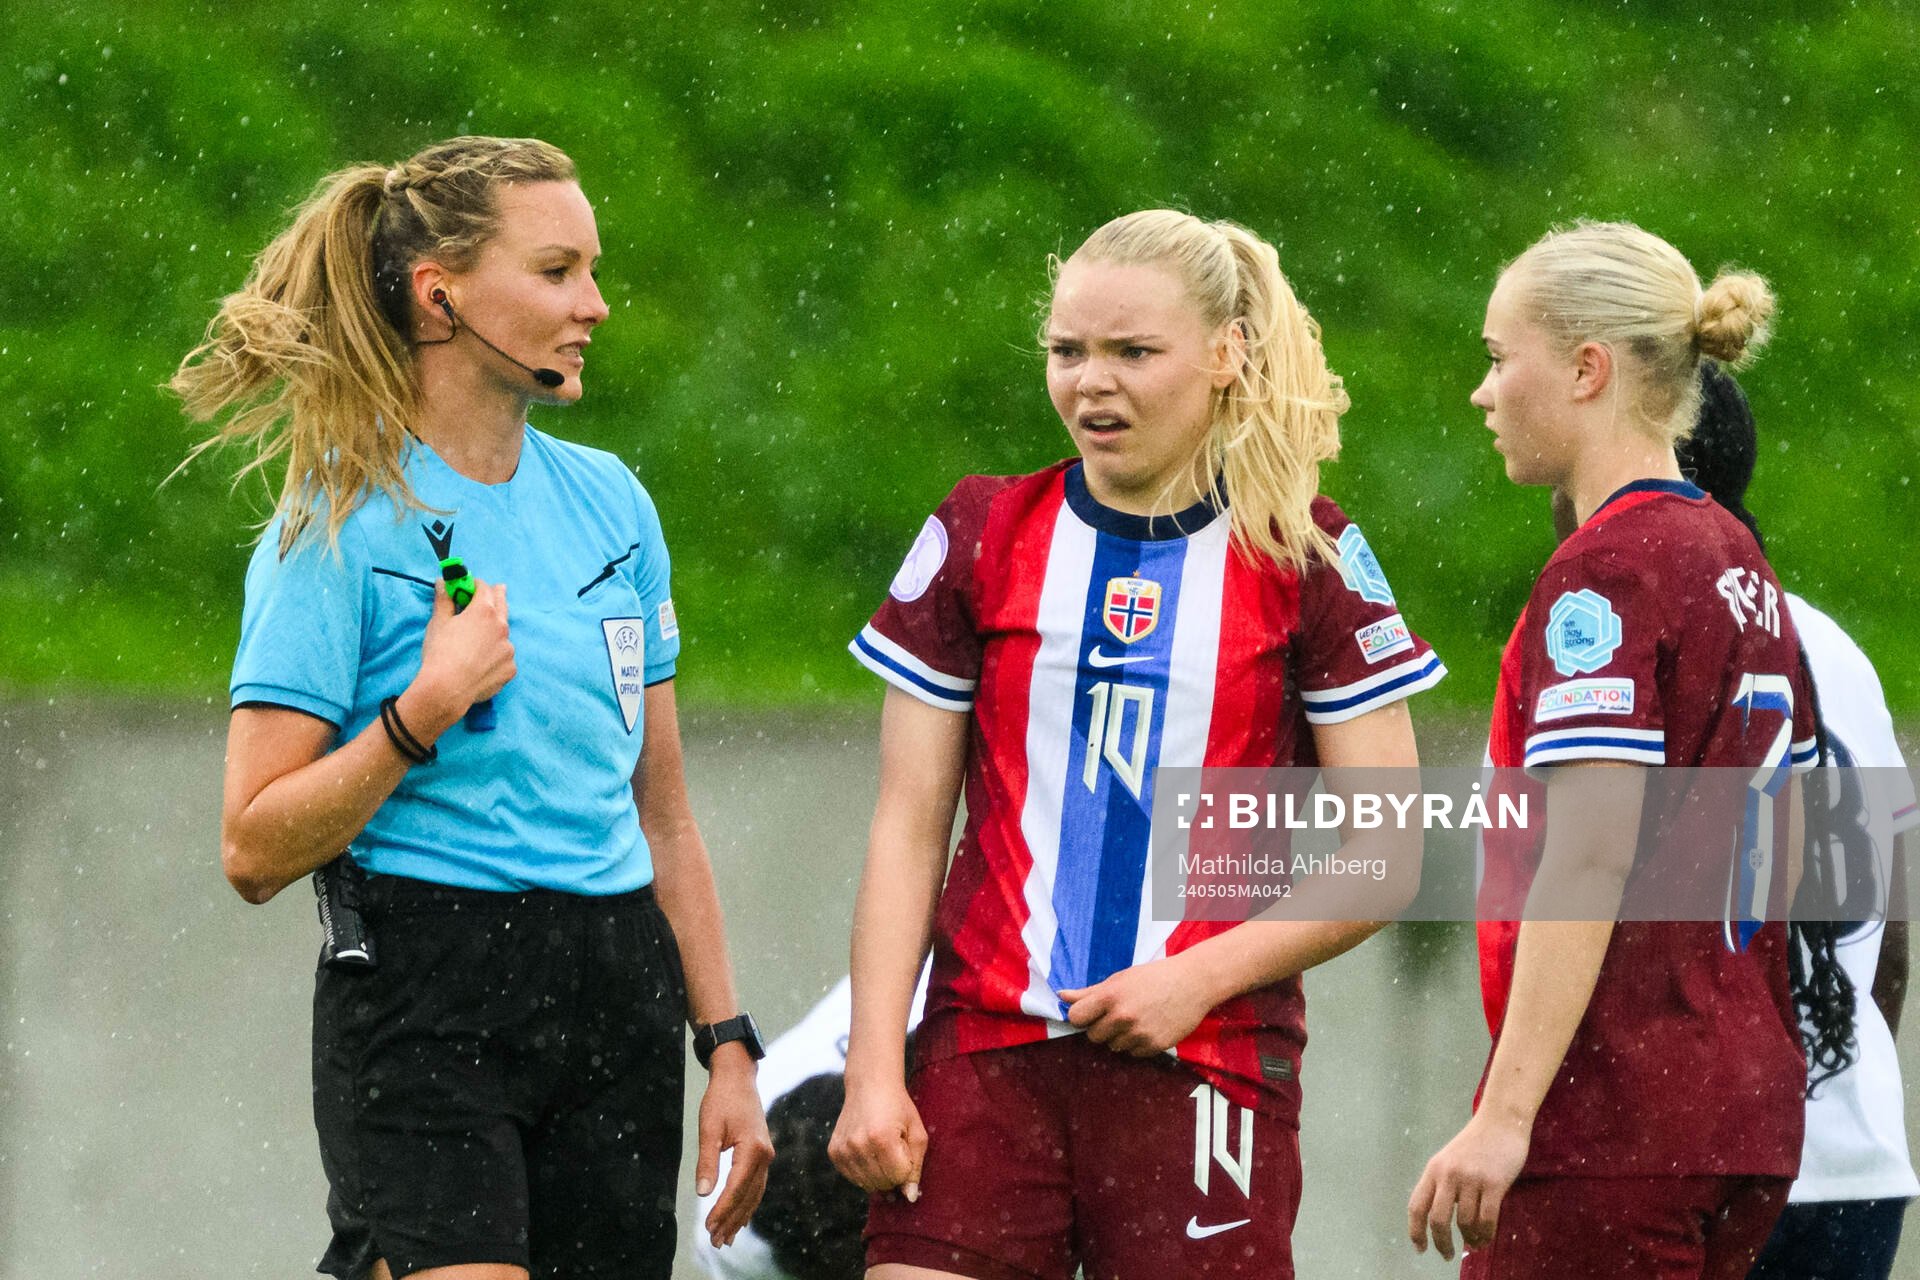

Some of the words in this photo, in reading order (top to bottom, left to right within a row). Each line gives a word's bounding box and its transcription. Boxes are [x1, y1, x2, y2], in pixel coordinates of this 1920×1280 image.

[615, 631, 639, 651] UEFA
[621, 666, 639, 678] MATCH
[619, 683, 641, 695] OFFICIAL
[1540, 689, 1631, 708] FOUNDATION
[1082, 681, 1155, 801] 10
[1188, 1083, 1254, 1200] 10
